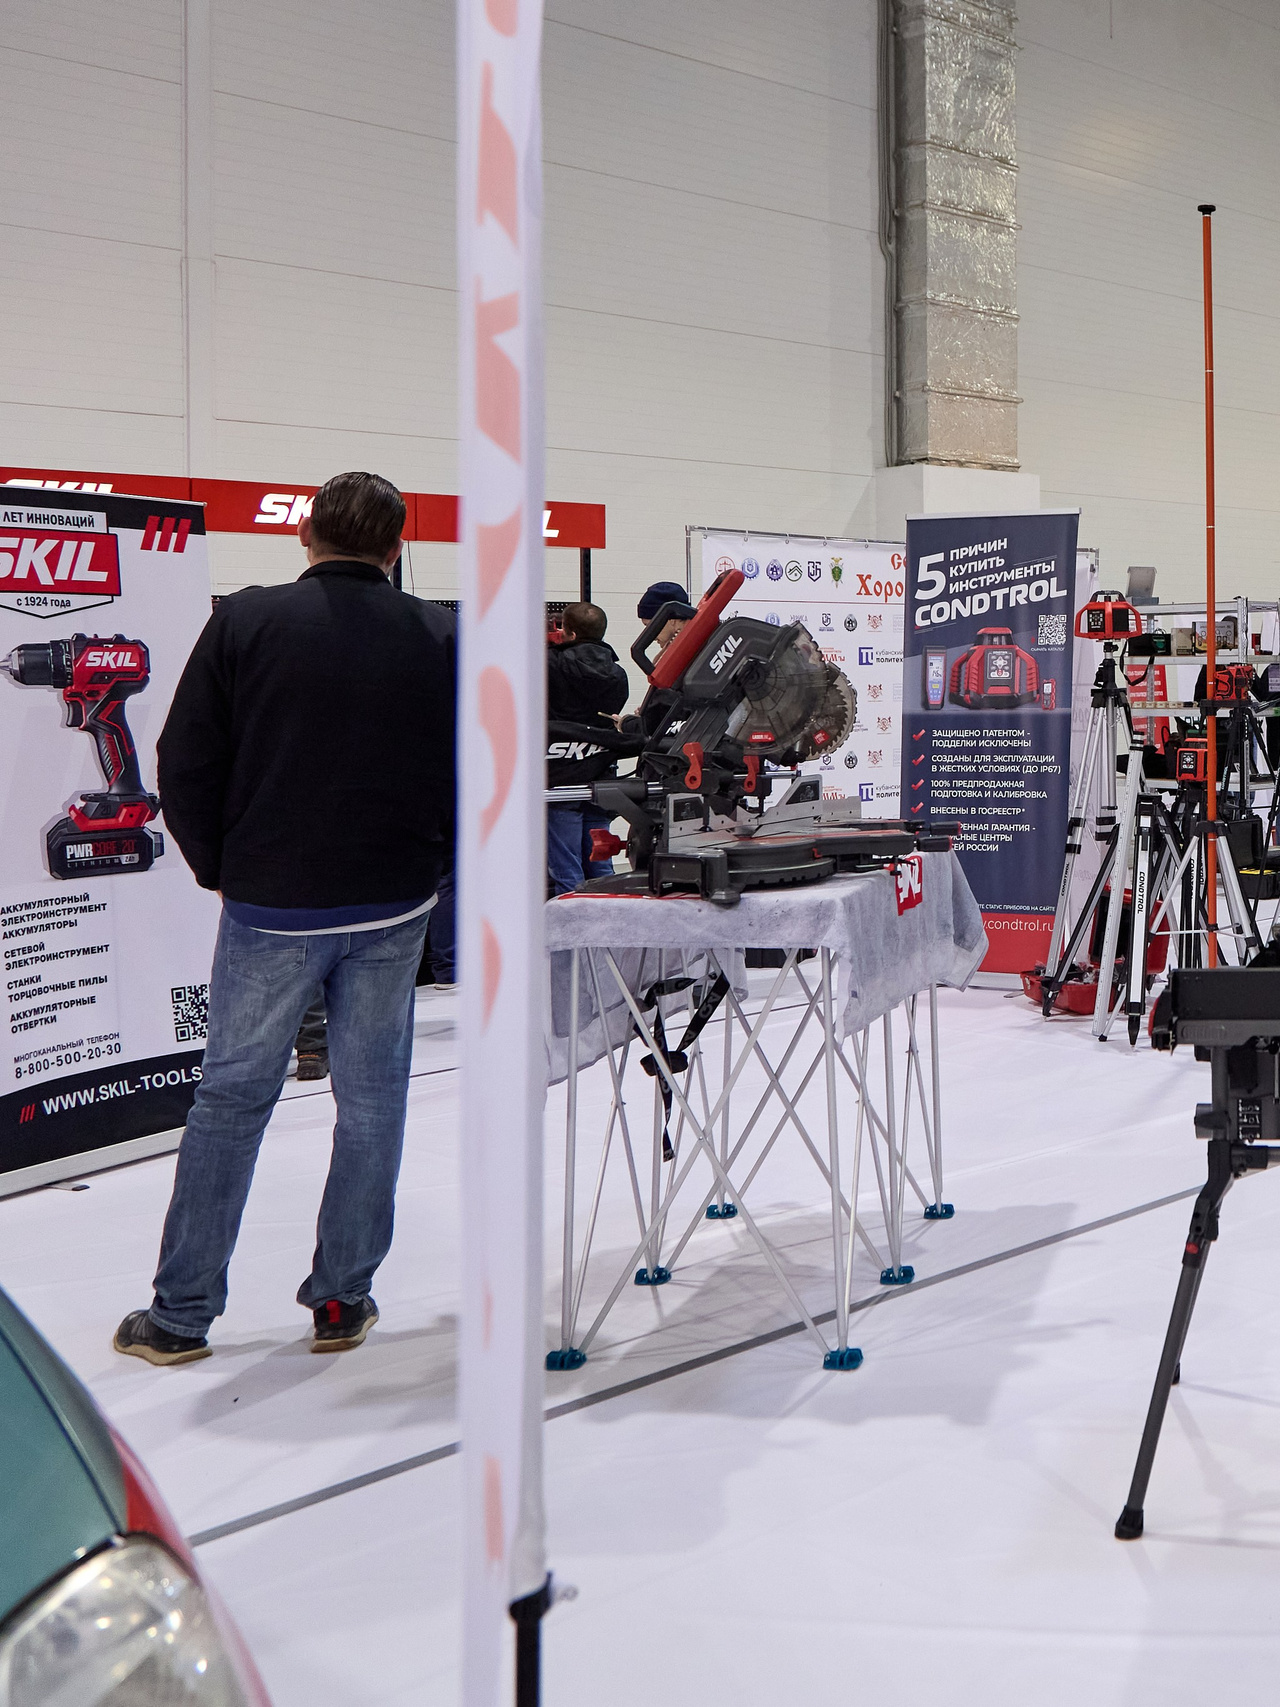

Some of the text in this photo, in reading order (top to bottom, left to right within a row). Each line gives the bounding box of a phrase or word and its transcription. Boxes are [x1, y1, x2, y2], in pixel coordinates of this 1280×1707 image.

[3, 512, 95, 528] ЛЕТ ИННОВАЦИЙ
[253, 494, 313, 525] SK
[950, 538, 1008, 561] ПРИЧИН
[0, 537, 109, 586] SKIL
[950, 556, 1005, 578] КУПИТЬ
[914, 552, 946, 600] 5
[949, 561, 1055, 594] ИНСТРУМЕНТЫ
[17, 596, 71, 608] с 1924 года
[915, 577, 1067, 627] CONDTROL
[85, 651, 137, 669] SKIL
[709, 635, 743, 674] SKIL
[932, 730, 981, 738] ЗАЩИЩЕНО
[932, 740, 976, 748] ПОДДЕЛКИ
[931, 755, 1055, 763] СОЗДАНЫ ДЛЯ ЭКСПЛУАТАЦИИ
[939, 765, 976, 773] ЖЕСТКИХ
[978, 765, 1020, 773] УСЛОВИЯХ
[1022, 765, 1038, 774] (ДО
[1040, 766, 1061, 774] IP67)
[931, 780, 1025, 788] 100% ПРЕДПРОДАЖНАЯ
[931, 790, 983, 799] ПОДГОТОВКА
[993, 791, 1047, 799] КАЛИБРОВКА
[876, 791, 900, 799] полите
[930, 807, 968, 815] ВНЕСЕНЫ
[971, 807, 976, 815] В
[980, 834, 1012, 842] ЦЕНТРЫ
[991, 824, 1030, 832] ГАРАНТИЯ
[1061, 863, 1070, 897] CONDTROL
[1137, 871, 1146, 914] CONDTROL
[0, 892, 90, 915] АККУМУЛЯТОРНЫЙ
[1, 903, 107, 927] ЭЛЕКТРОИНСТРУМЕНТ
[2, 919, 78, 940] АККУМУЛЯТОРЫ
[4, 942, 45, 959] СЕТЕВОЙ
[5, 944, 110, 971] ЭЛЕКТРОИНСТРУМЕНТ
[7, 974, 42, 990] СТАНКИ
[8, 975, 108, 1003] ТОРЦОВОЧНЫЕ ПИЛЫ
[10, 995, 96, 1022] АККУМУЛЯТОРНЫЕ
[11, 1015, 57, 1034] ОТВЕРТКИ
[14, 1032, 120, 1064] МНОГОКАНАЛЬНЫЙ ТЕЛЕФОН
[15, 1042, 122, 1079] 8-800-500-20-30
